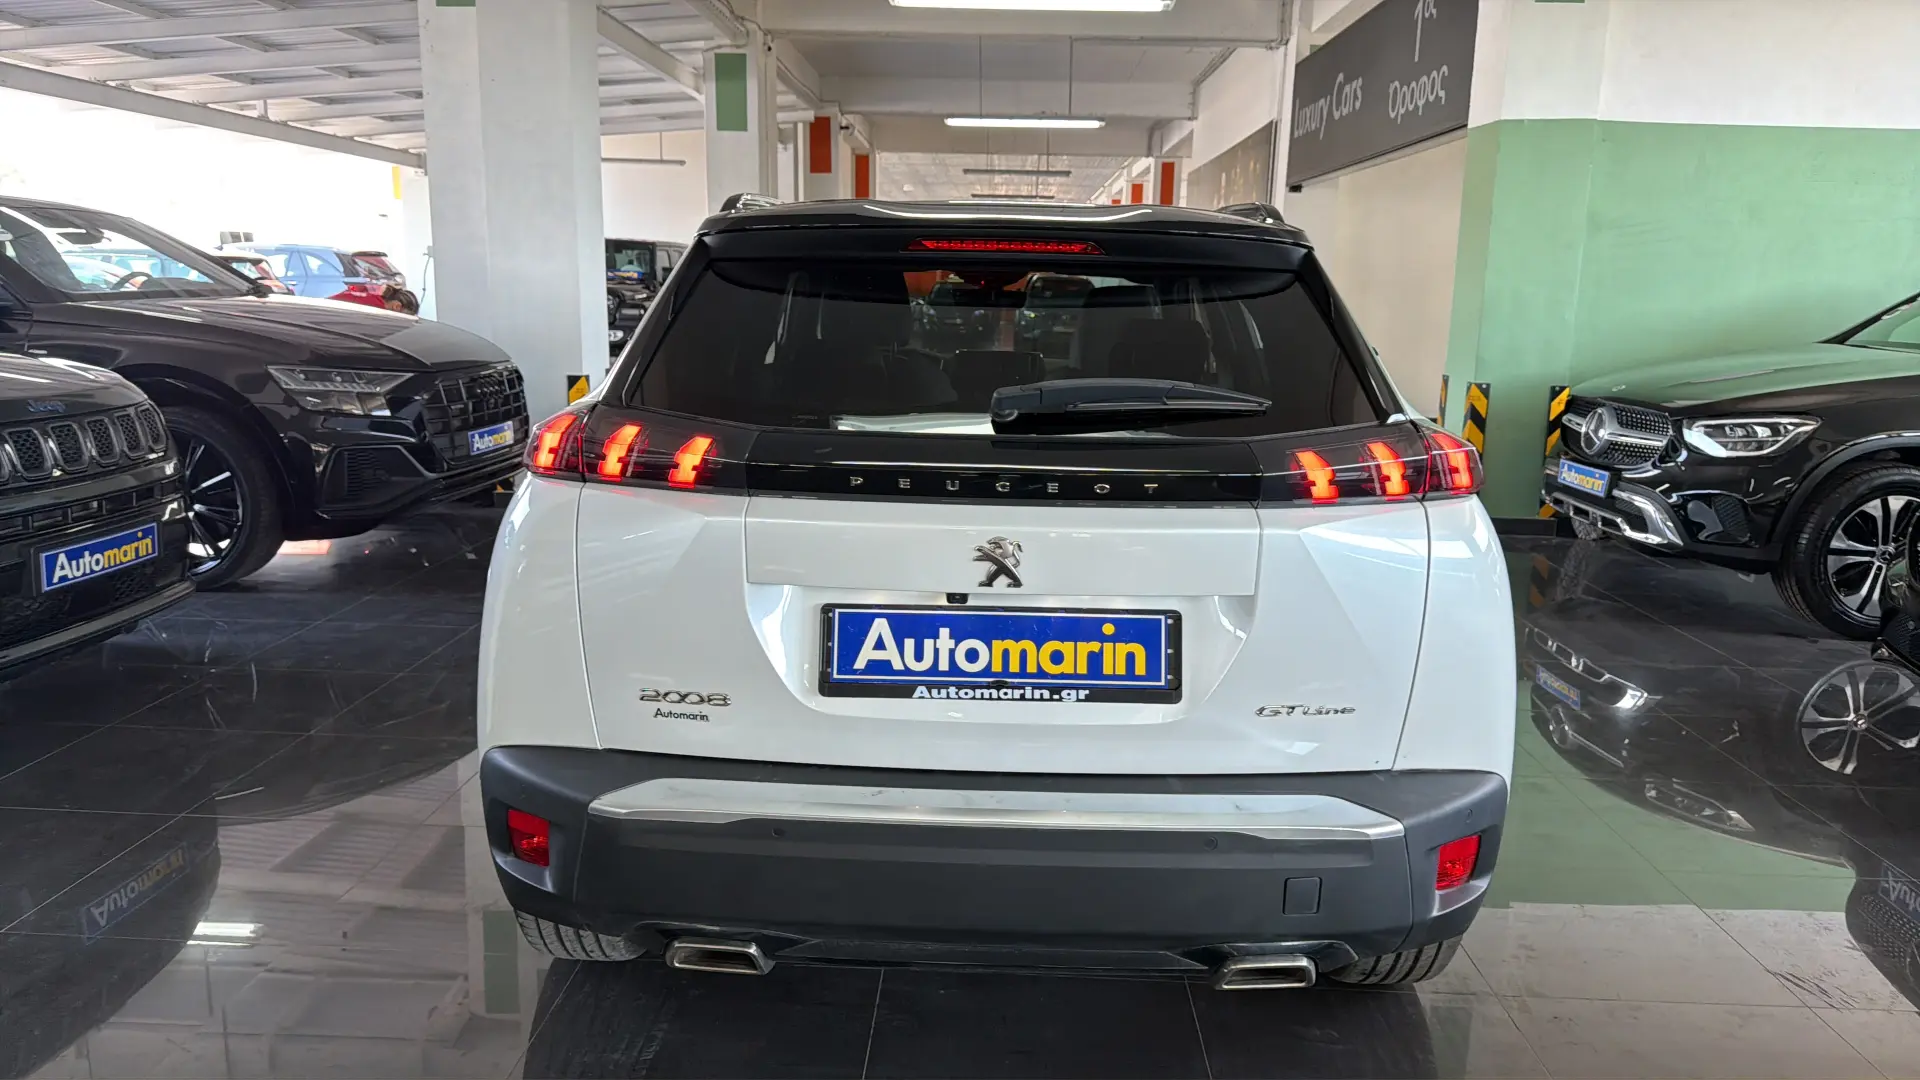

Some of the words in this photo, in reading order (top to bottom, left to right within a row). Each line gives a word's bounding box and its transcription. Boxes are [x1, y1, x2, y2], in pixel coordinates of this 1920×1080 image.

[1294, 95, 1330, 140] Luxury
[1333, 72, 1362, 120] Cars
[849, 476, 1157, 494] PEUGEOT
[52, 531, 153, 583] Automarin
[852, 617, 1146, 676] Automarin
[639, 687, 732, 706] 2008
[912, 685, 1090, 702] Automarin.gr
[653, 707, 710, 722] Automarin
